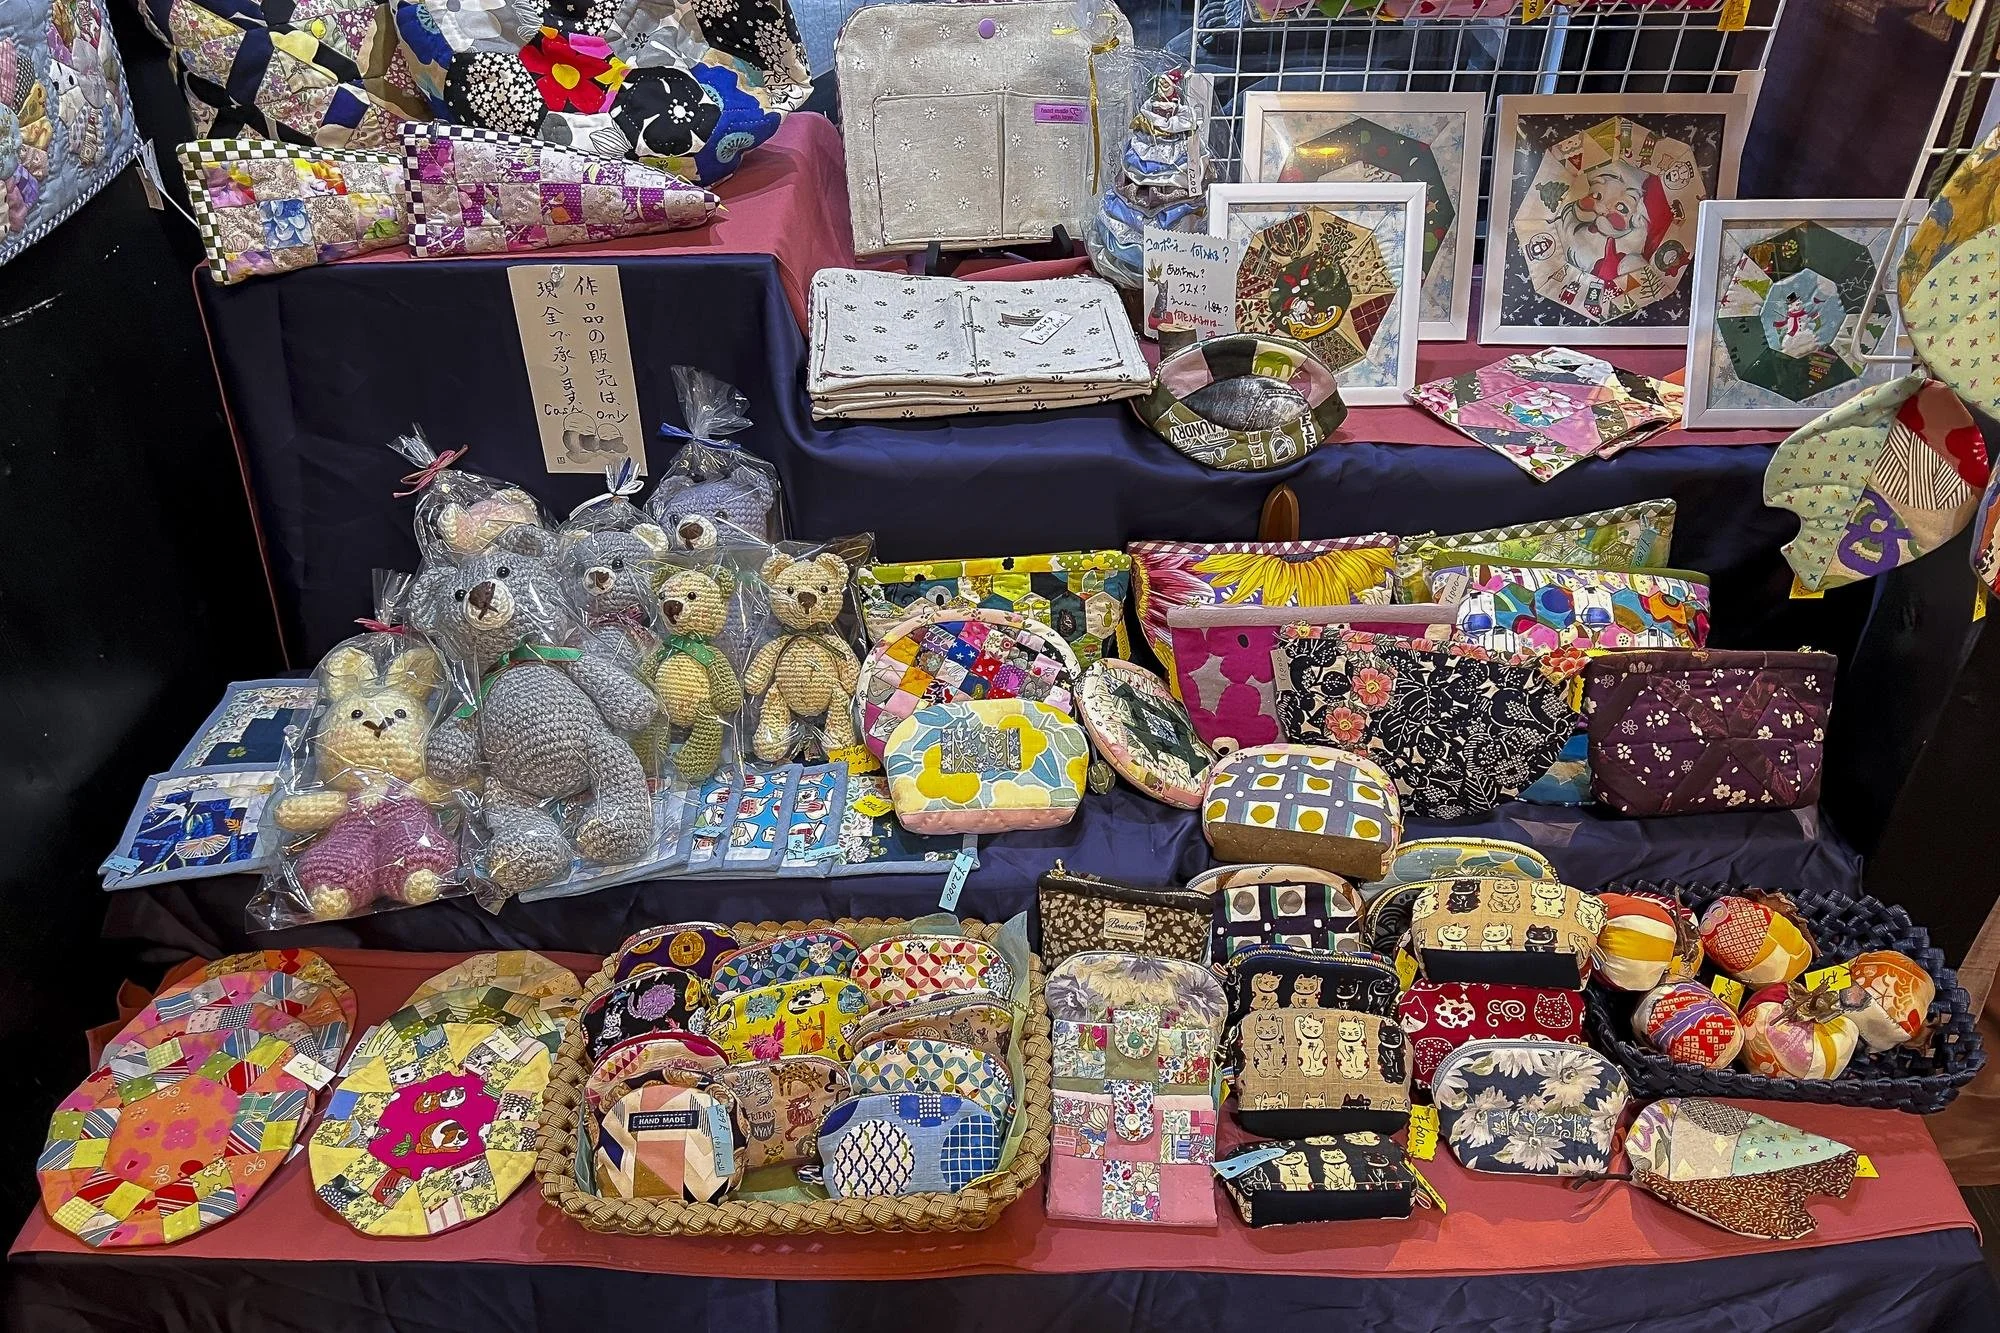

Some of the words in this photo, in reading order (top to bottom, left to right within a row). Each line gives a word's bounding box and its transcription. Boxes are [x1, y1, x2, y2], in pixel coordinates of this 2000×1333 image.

[544, 403, 583, 416] Cash
[638, 1117, 660, 1125] HAND
[662, 1116, 686, 1124] MADE
